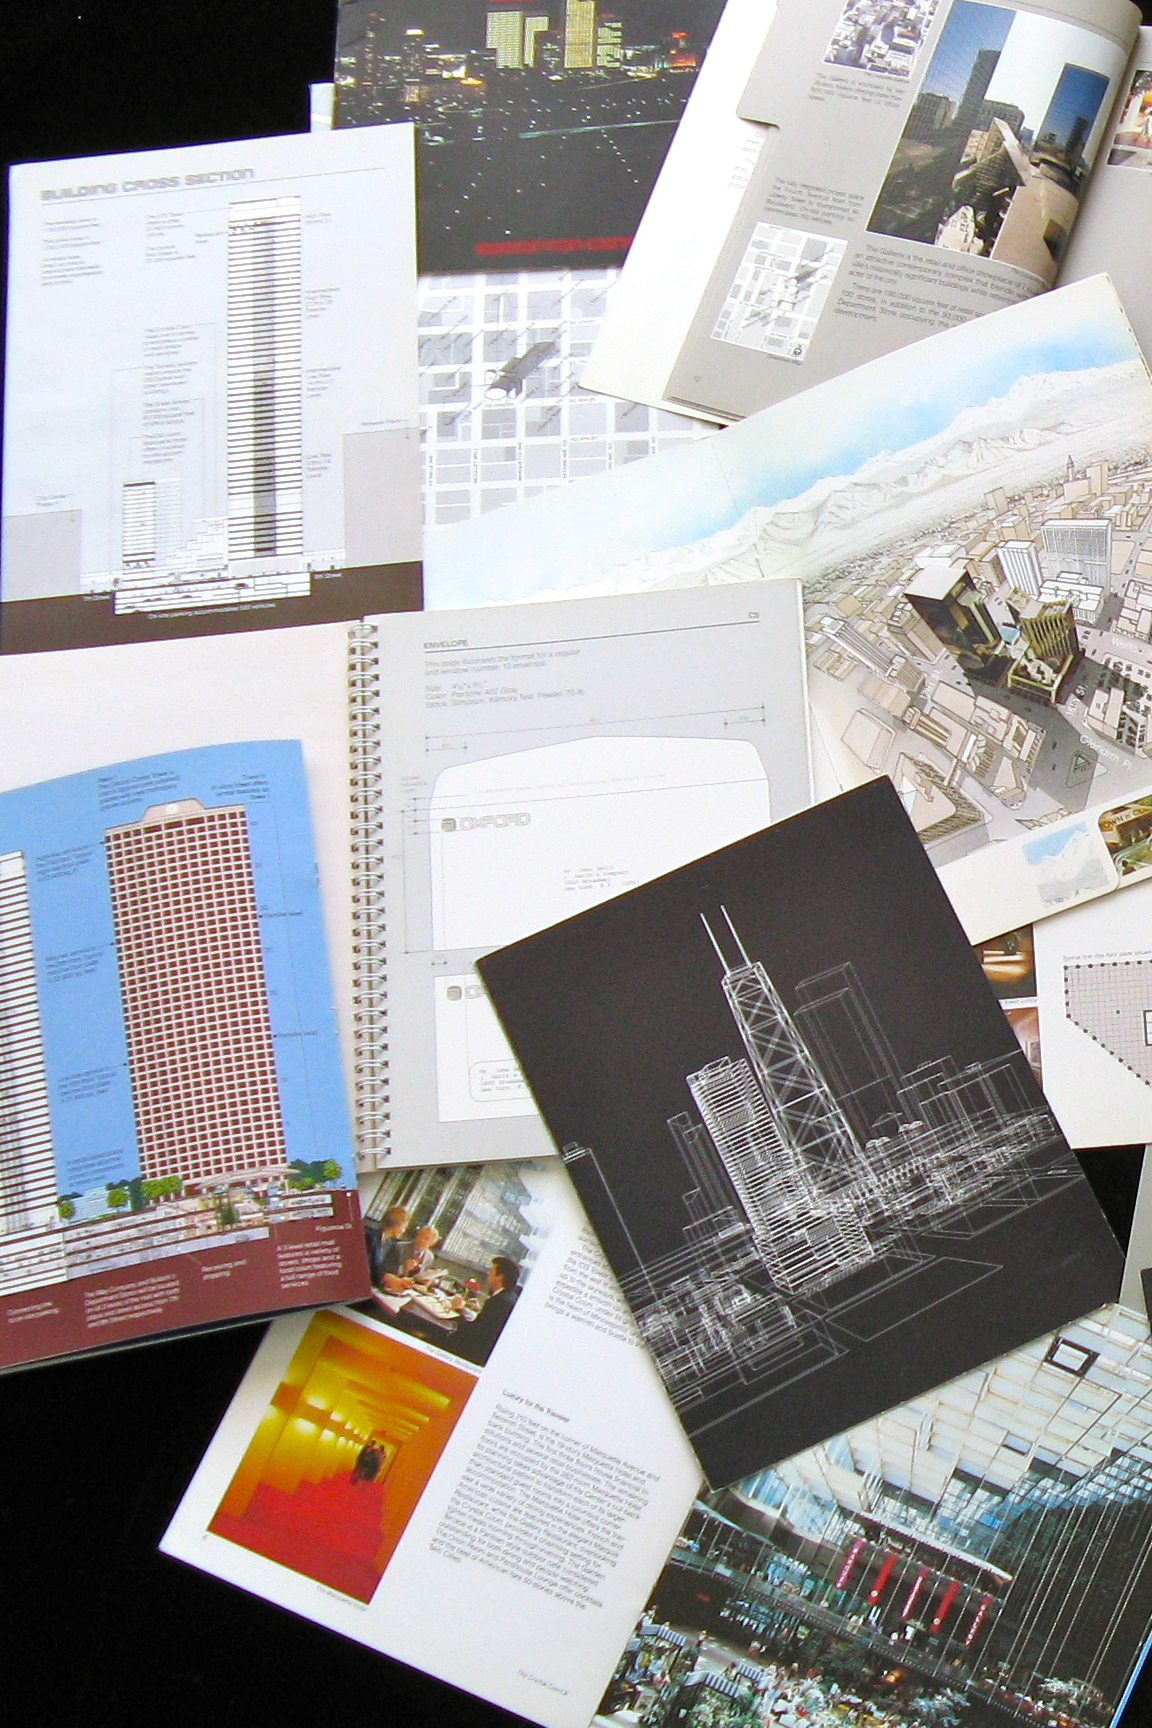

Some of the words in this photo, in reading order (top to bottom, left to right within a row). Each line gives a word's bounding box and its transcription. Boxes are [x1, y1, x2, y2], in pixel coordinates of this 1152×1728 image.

[40, 182, 119, 201] BUILDING
[121, 175, 179, 192] CROSS
[183, 167, 254, 185] SECTION
[424, 639, 469, 649] ENVELOPE
[460, 812, 530, 831] OXFORD
